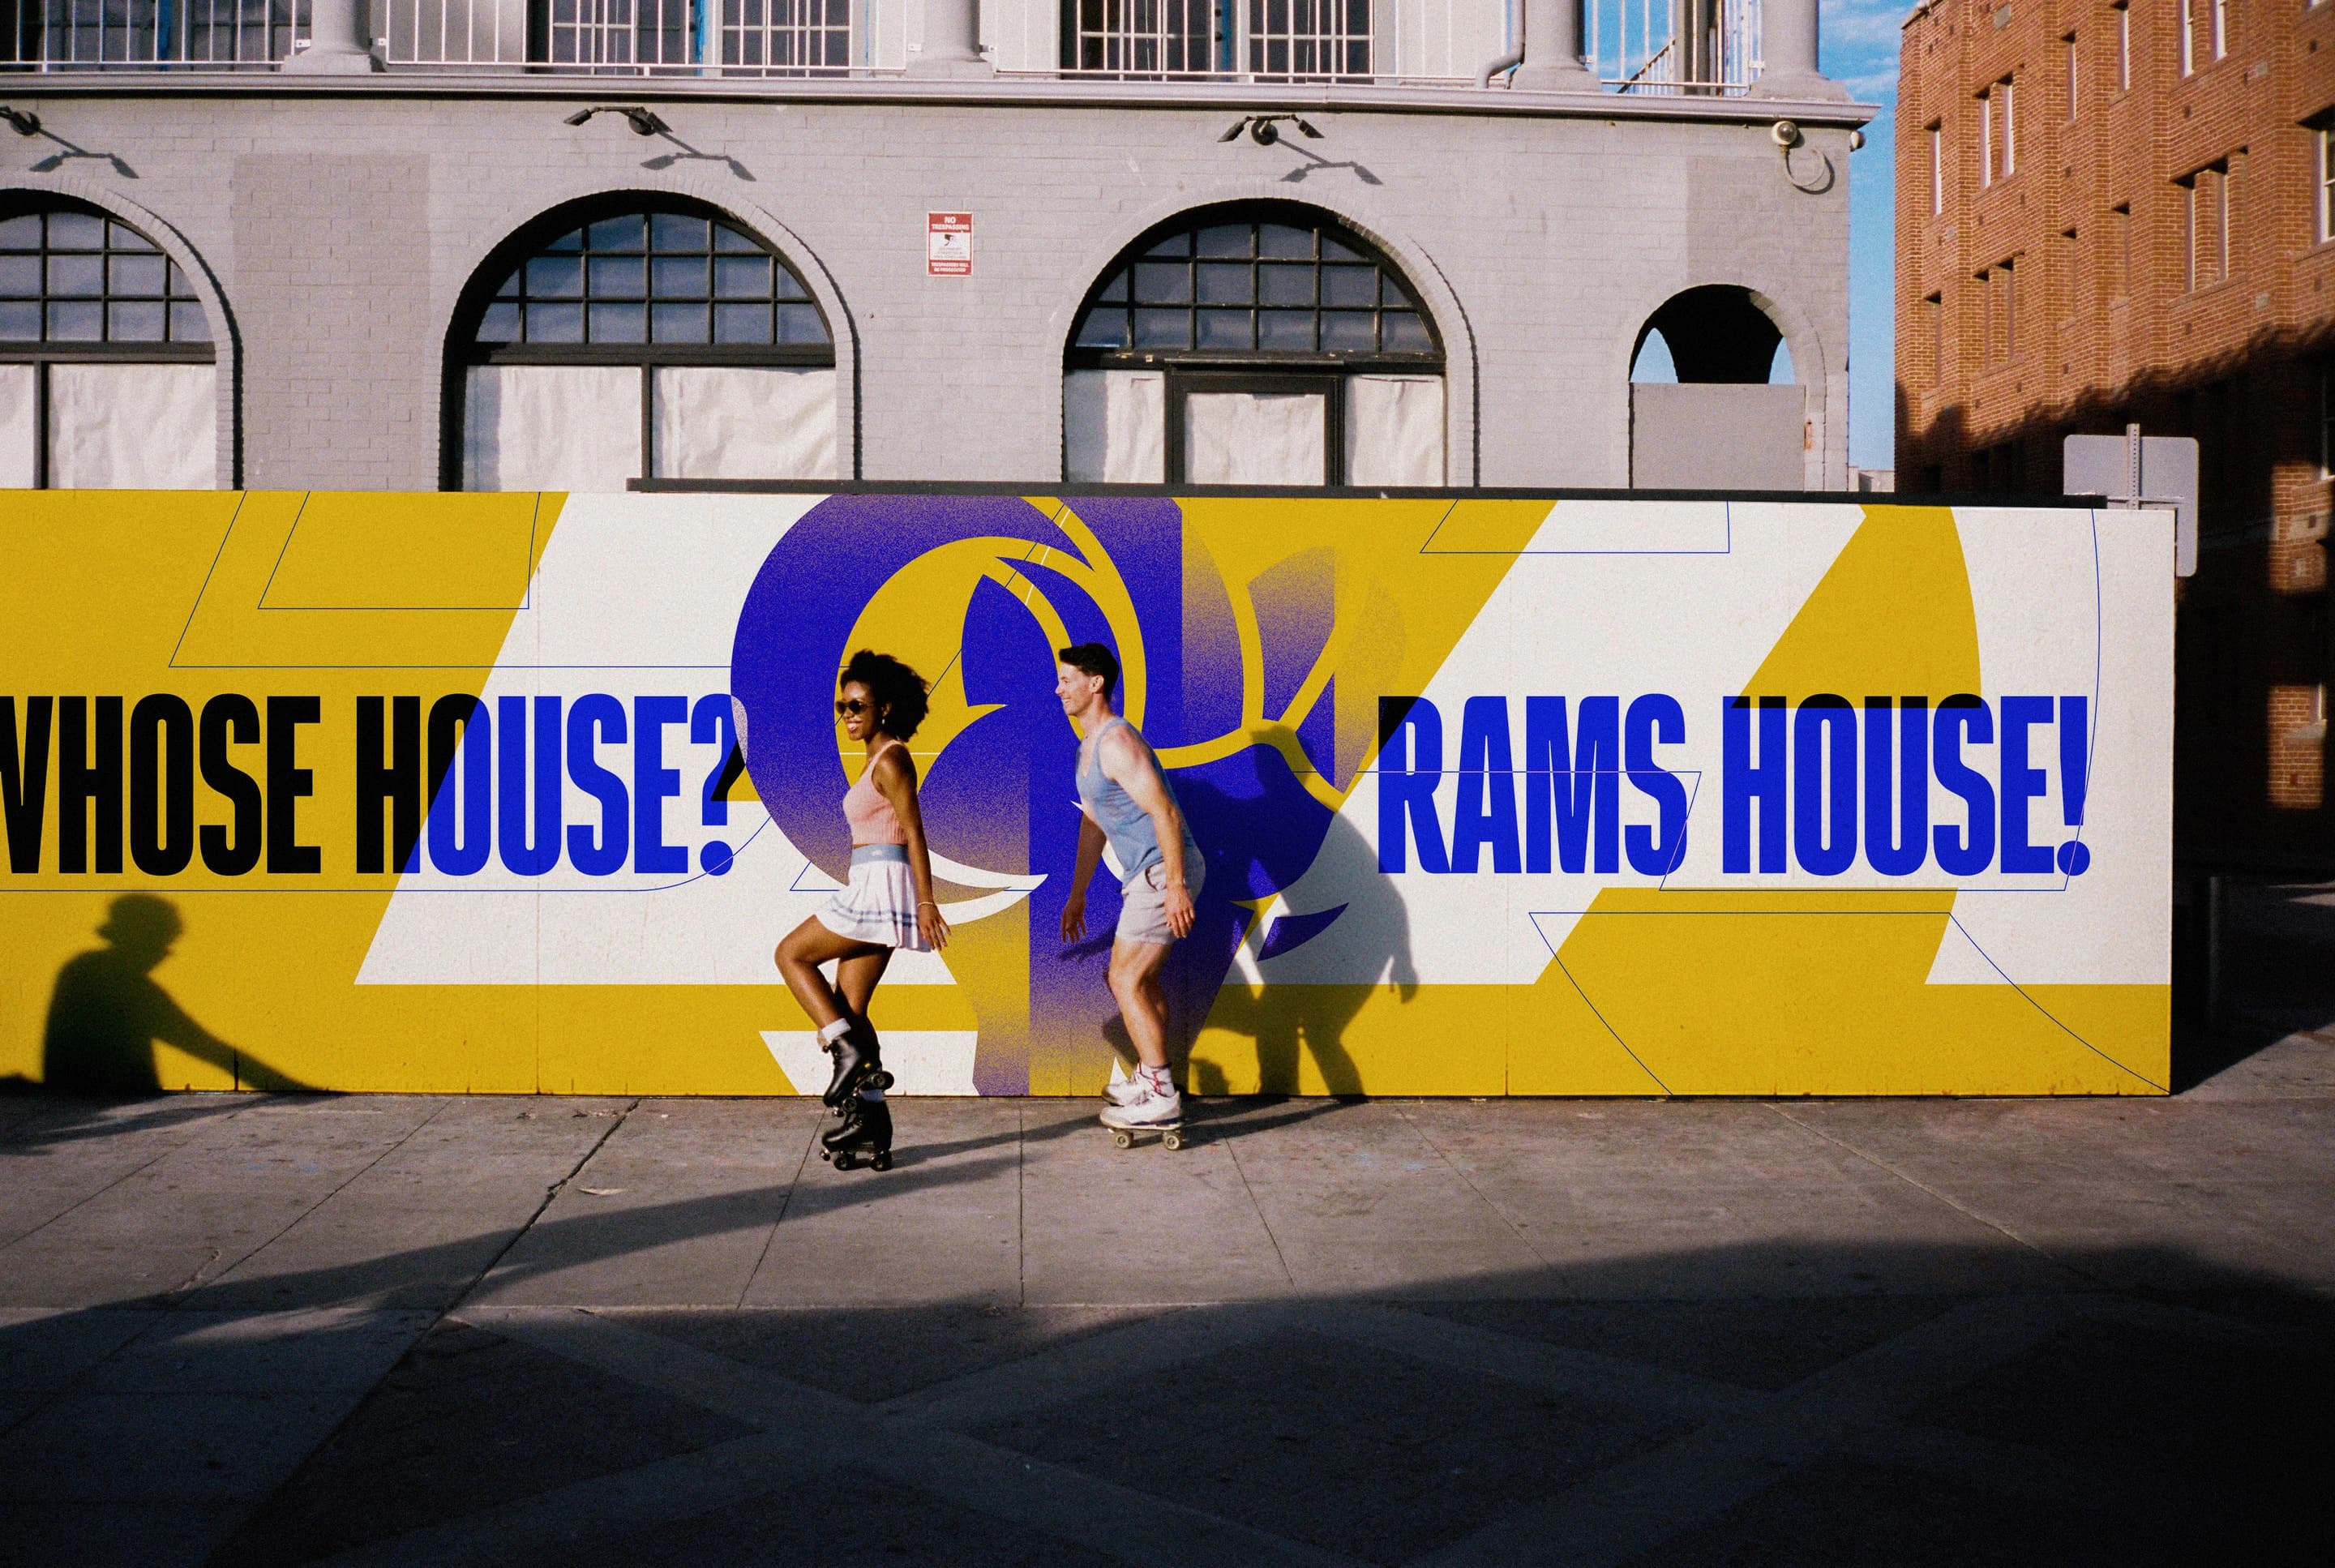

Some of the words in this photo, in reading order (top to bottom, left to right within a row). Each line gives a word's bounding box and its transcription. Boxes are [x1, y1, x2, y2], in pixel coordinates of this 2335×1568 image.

[357, 694, 748, 876] HOUSE?
[1378, 694, 1688, 876] RAMS
[1724, 694, 2090, 876] HOUSE!
